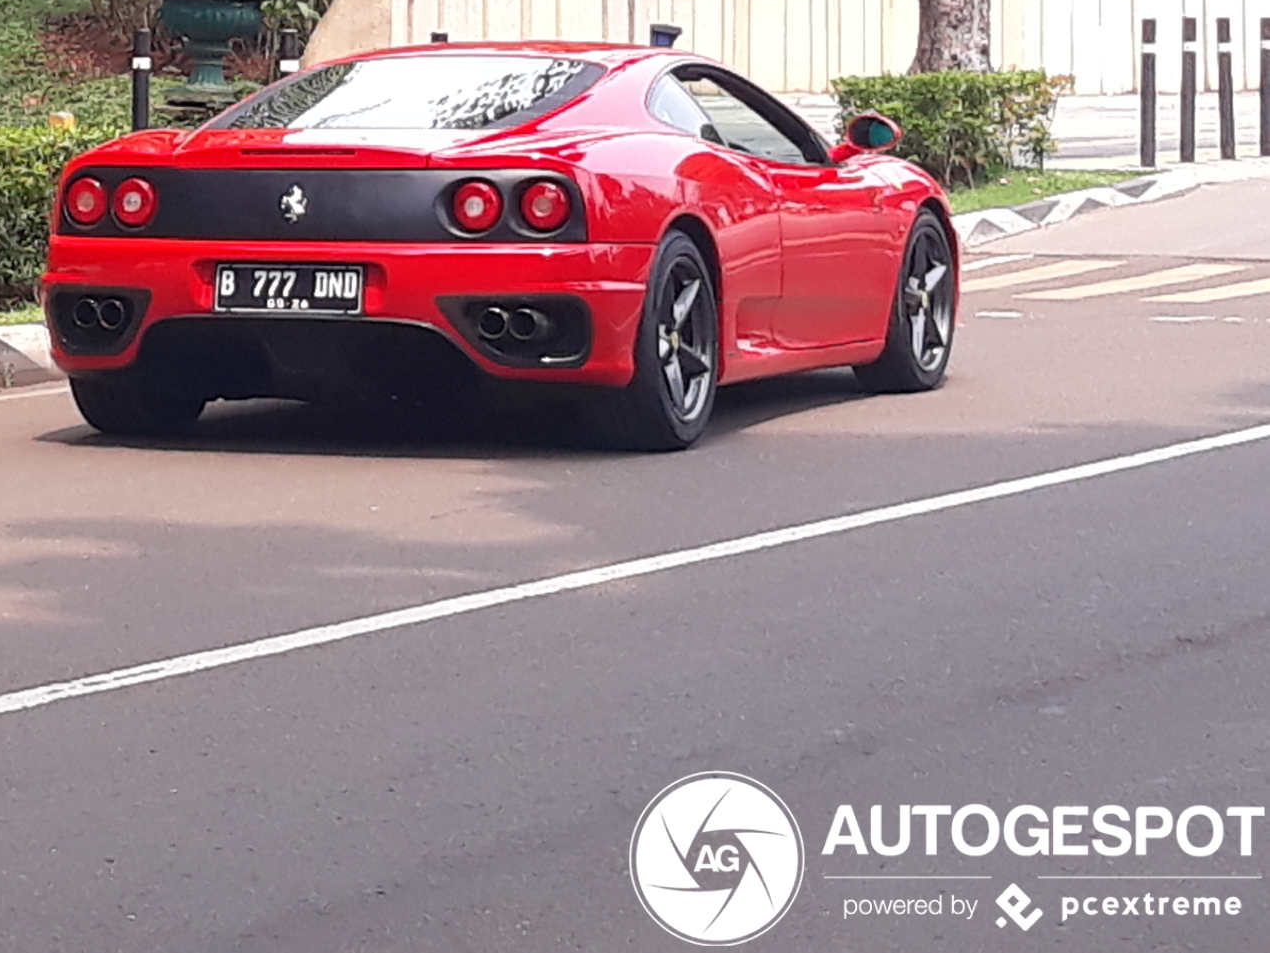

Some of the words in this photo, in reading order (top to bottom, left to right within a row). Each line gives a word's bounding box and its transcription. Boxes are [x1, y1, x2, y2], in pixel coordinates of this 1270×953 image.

[220, 270, 236, 296] B
[253, 270, 297, 297] 777
[313, 271, 357, 298] DND
